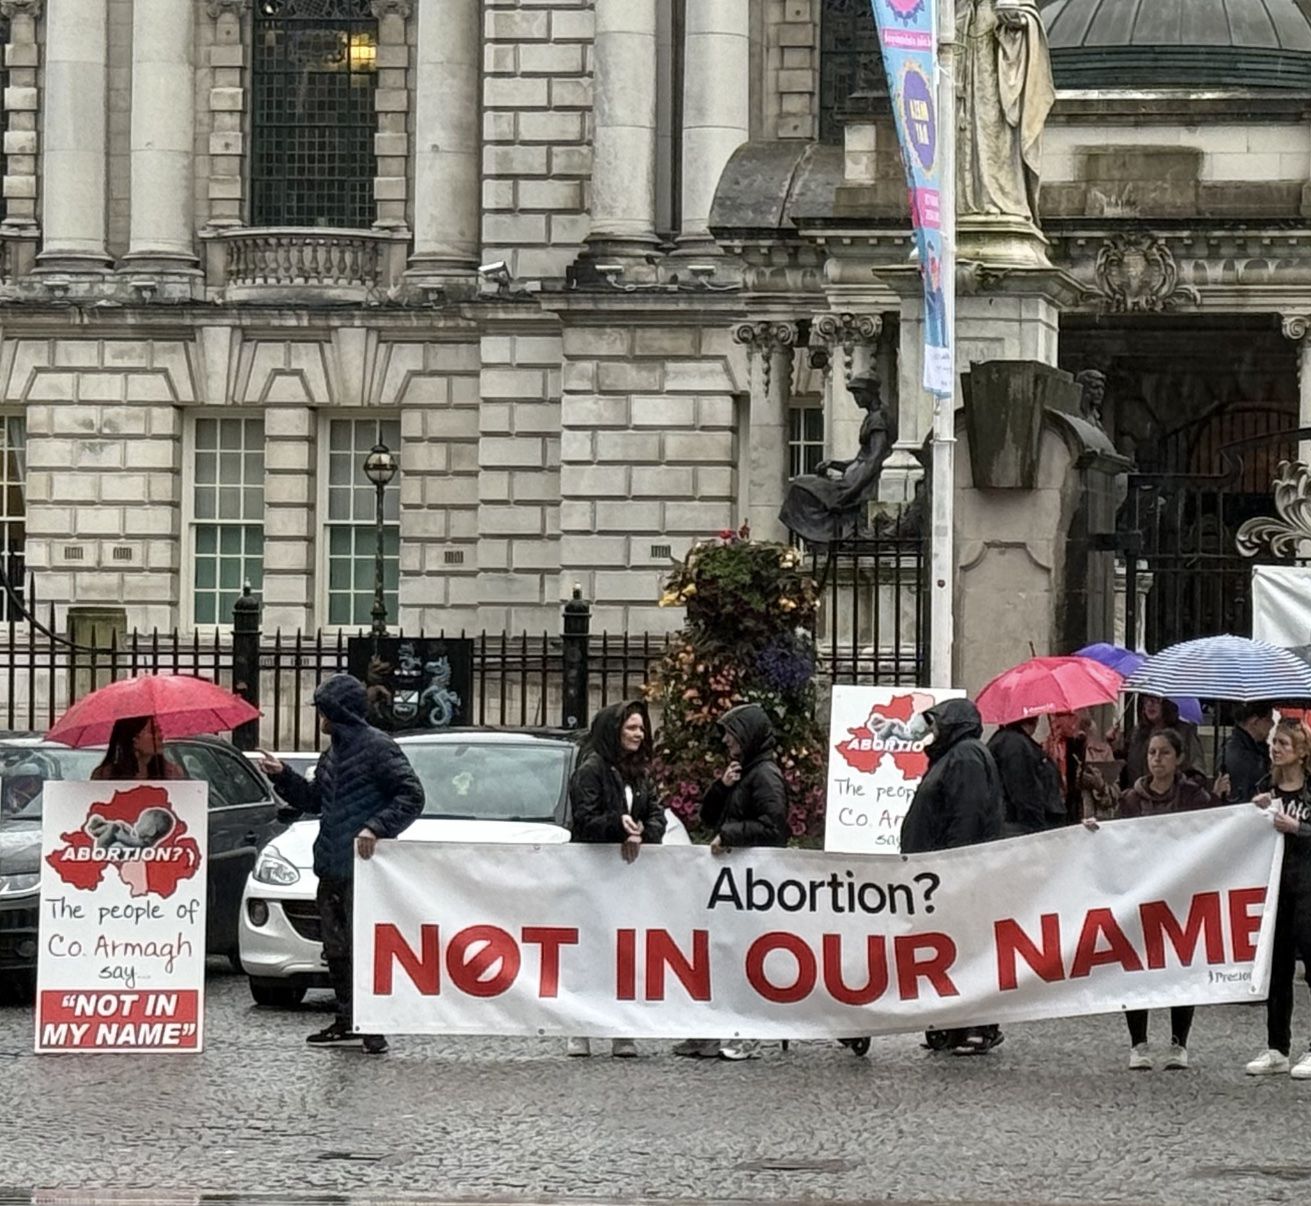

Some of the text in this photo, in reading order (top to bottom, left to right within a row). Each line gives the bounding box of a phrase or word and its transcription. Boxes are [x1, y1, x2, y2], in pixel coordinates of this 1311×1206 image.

[847, 738, 926, 753] ABORTIO
[833, 777, 917, 802] The peop
[60, 846, 184, 863] ABORTION?
[706, 866, 942, 916] Abortion?
[45, 896, 200, 926] The people of
[47, 932, 193, 974] Co. Armagh
[372, 886, 1268, 1008] NOT IN OUR NAME
[61, 994, 178, 1018] “NOT IN
[41, 1022, 196, 1046] MY NAME”
